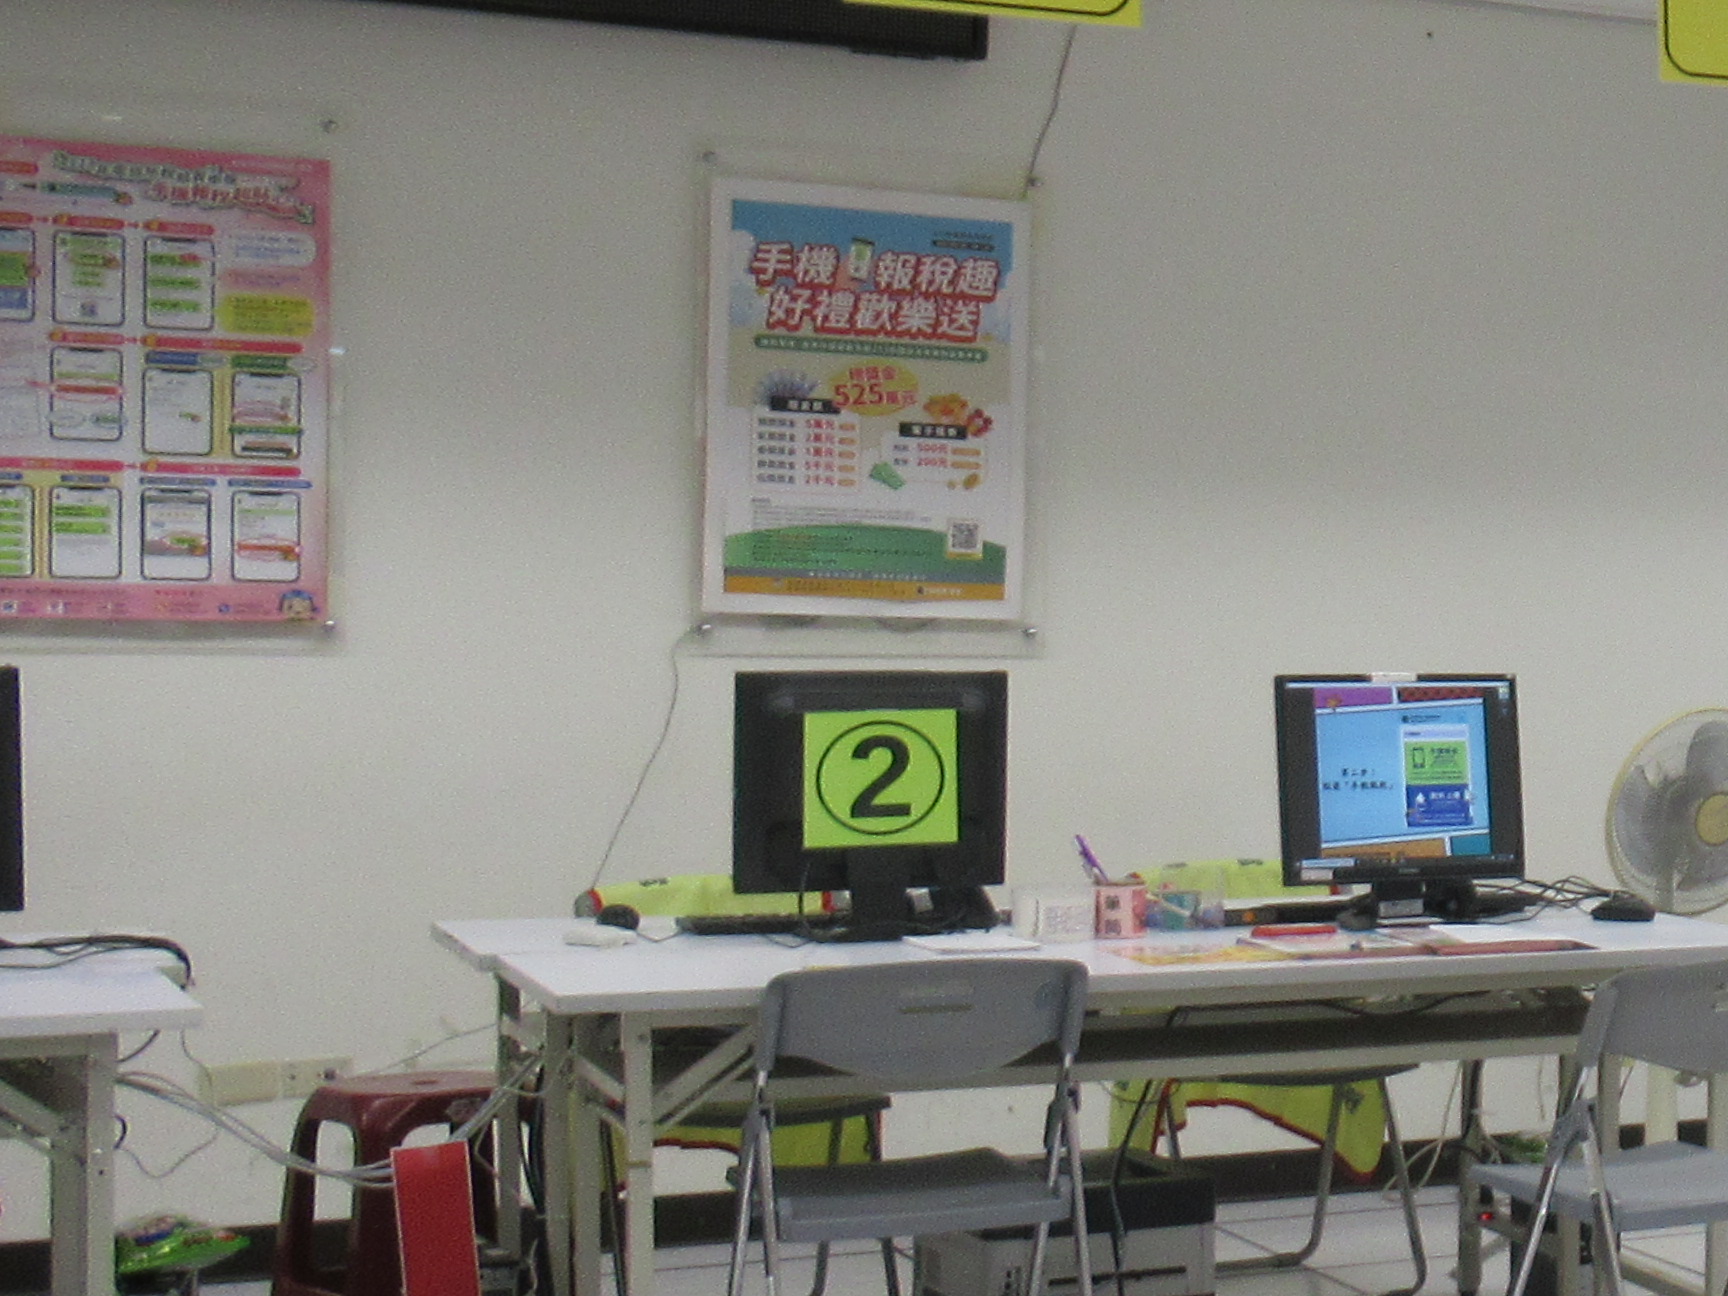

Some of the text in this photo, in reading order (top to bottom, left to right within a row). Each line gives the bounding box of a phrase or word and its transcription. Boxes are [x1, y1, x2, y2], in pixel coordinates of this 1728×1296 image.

[767, 286, 980, 341] 好禮歡樂送
[850, 734, 912, 819] 2
